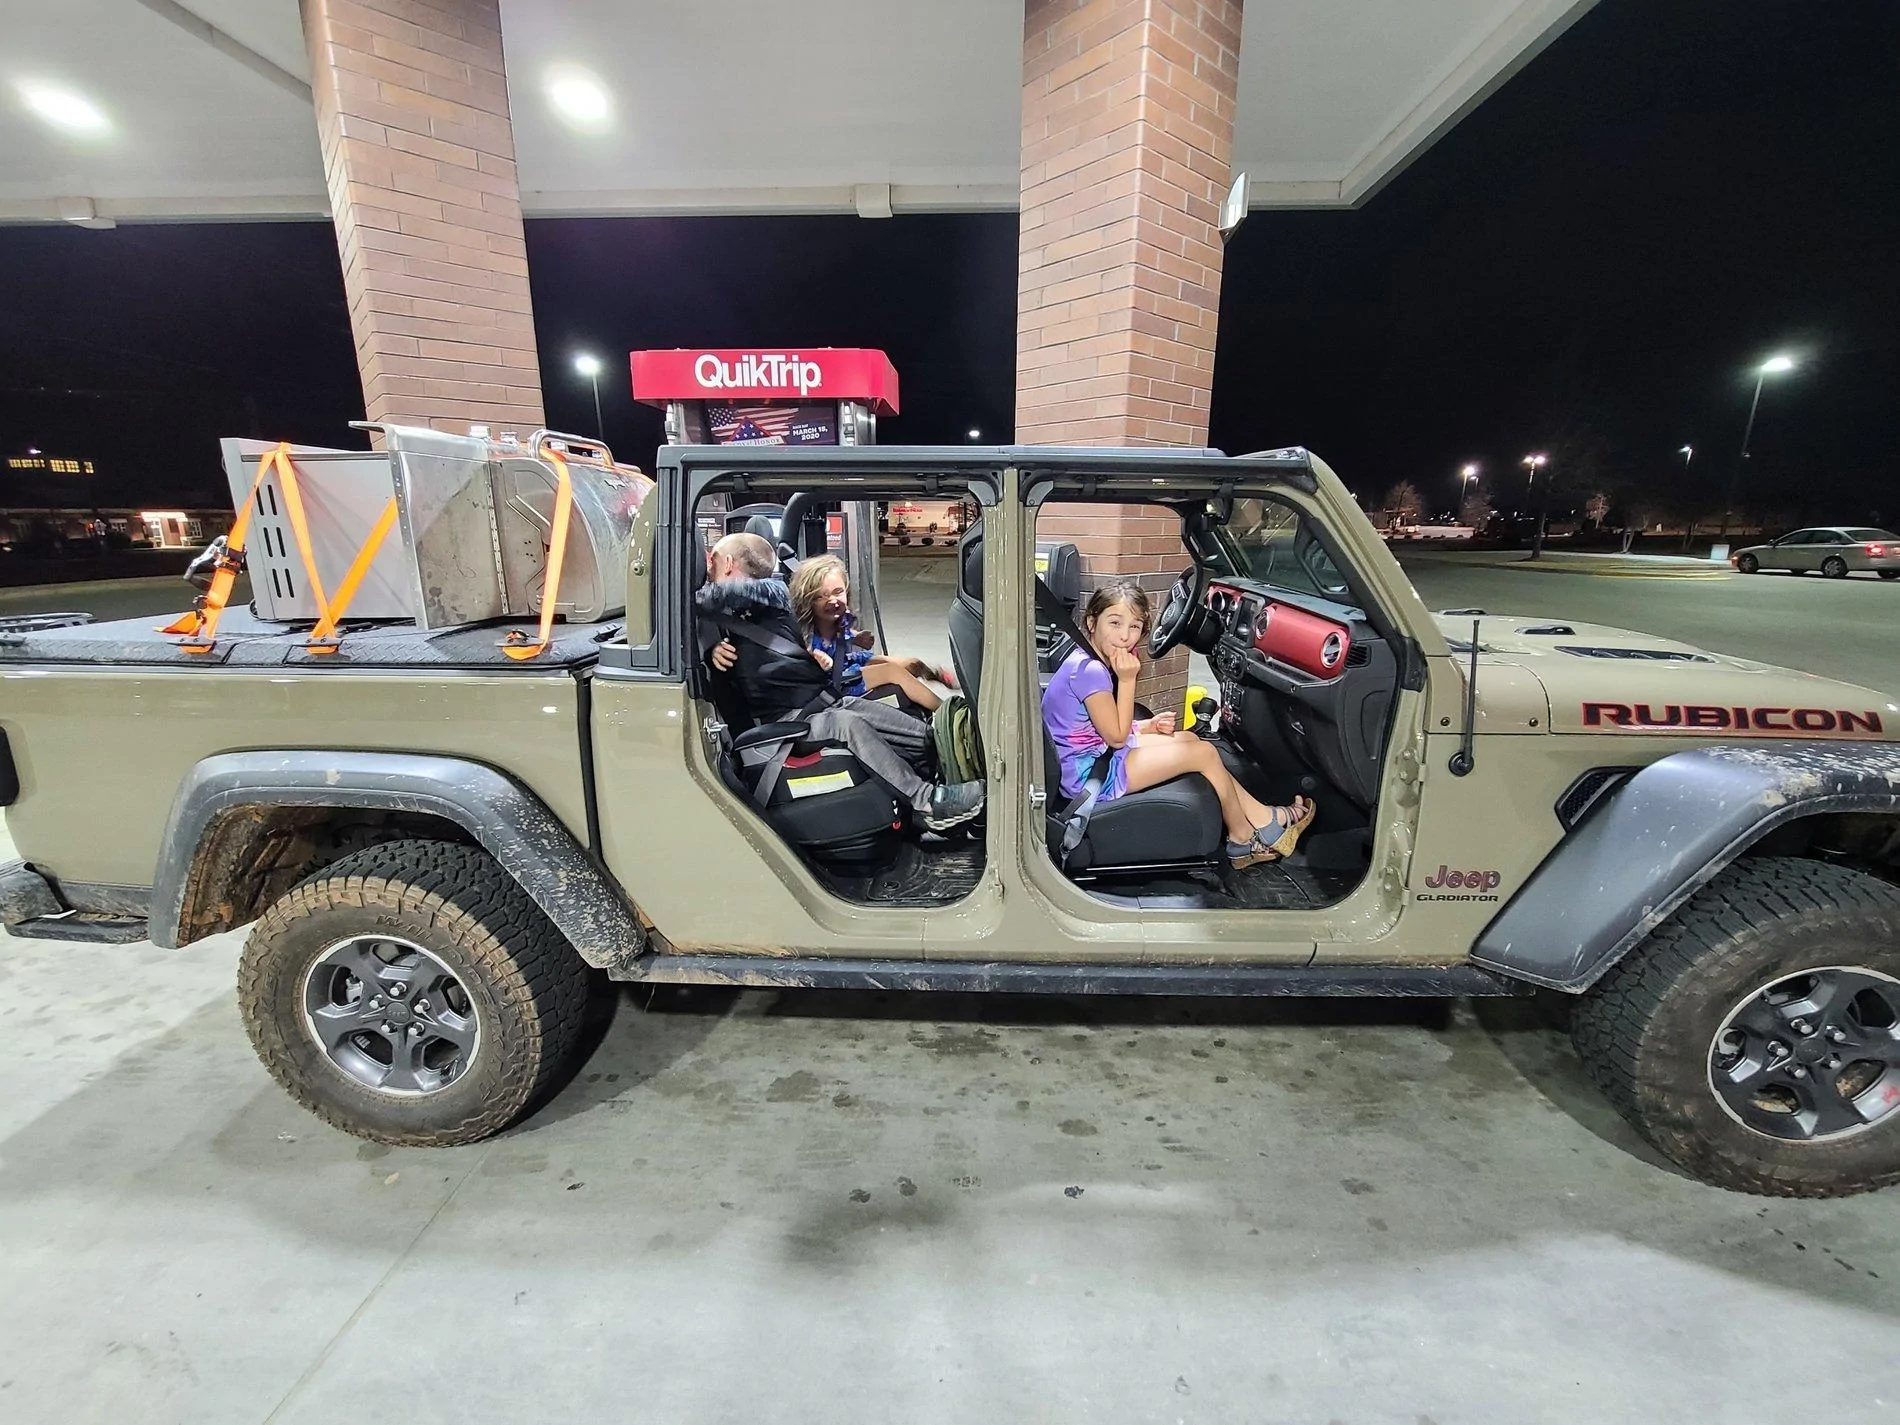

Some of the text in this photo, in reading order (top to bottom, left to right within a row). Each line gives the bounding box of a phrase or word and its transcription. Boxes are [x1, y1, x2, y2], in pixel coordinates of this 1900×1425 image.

[694, 354, 821, 395] QuikTrip
[792, 427, 817, 436] MARCH
[801, 432, 820, 440] 2020
[1582, 702, 1883, 733] RUBICON
[1425, 865, 1501, 892] Jeep
